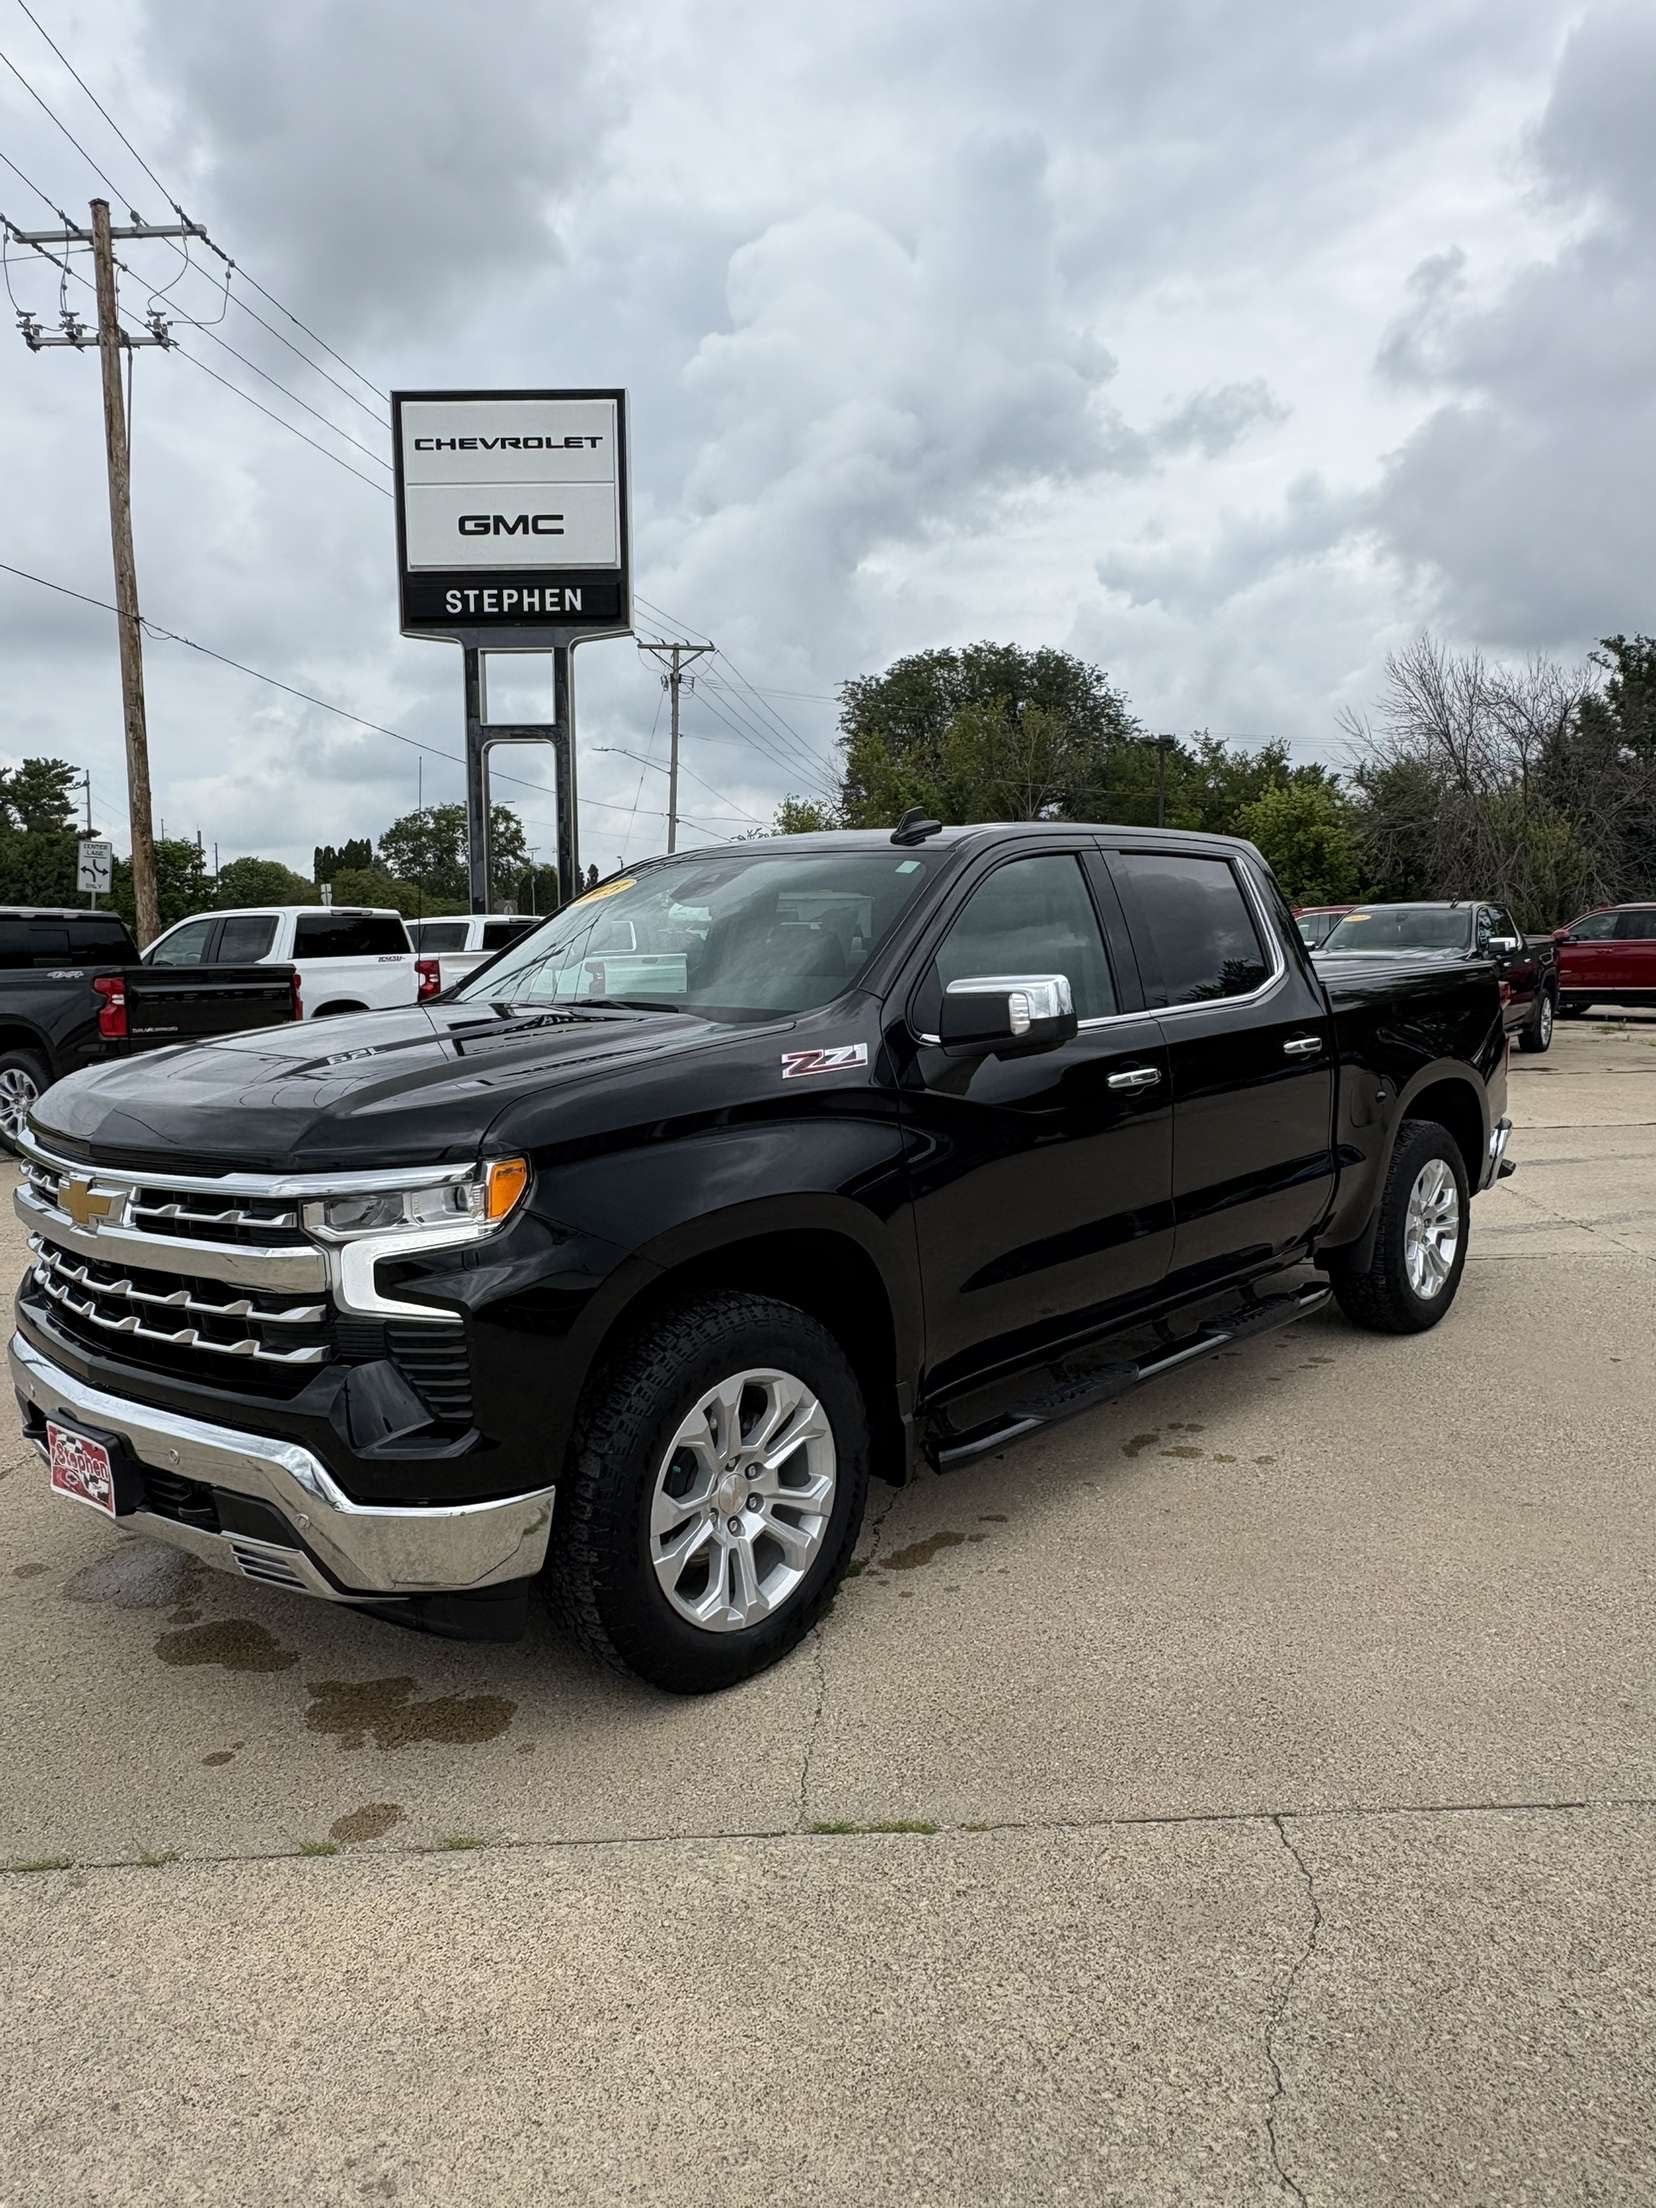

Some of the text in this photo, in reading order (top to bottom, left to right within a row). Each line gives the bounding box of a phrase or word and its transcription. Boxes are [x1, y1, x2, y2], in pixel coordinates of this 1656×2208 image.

[414, 436, 603, 450] CHEVROLET
[458, 514, 565, 536] GMC
[445, 588, 583, 614] STEPHEN
[781, 1042, 868, 1079] Z71
